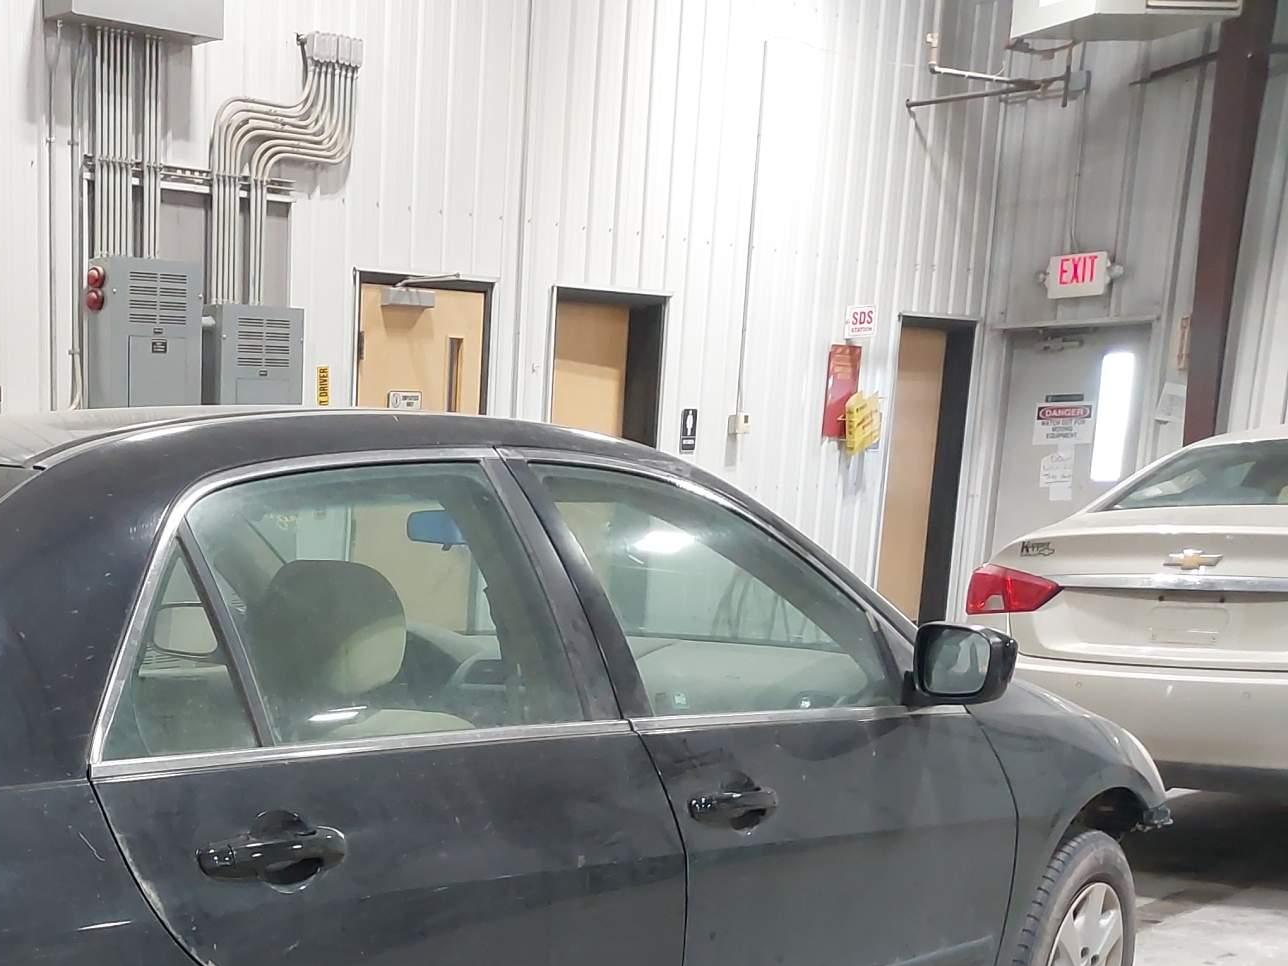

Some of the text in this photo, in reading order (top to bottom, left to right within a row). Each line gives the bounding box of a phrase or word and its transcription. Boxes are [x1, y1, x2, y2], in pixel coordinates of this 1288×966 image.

[1059, 255, 1098, 285] EXIT
[851, 310, 874, 325] SDS
[318, 368, 329, 397] DRIVER
[1045, 408, 1084, 417] DANGER
